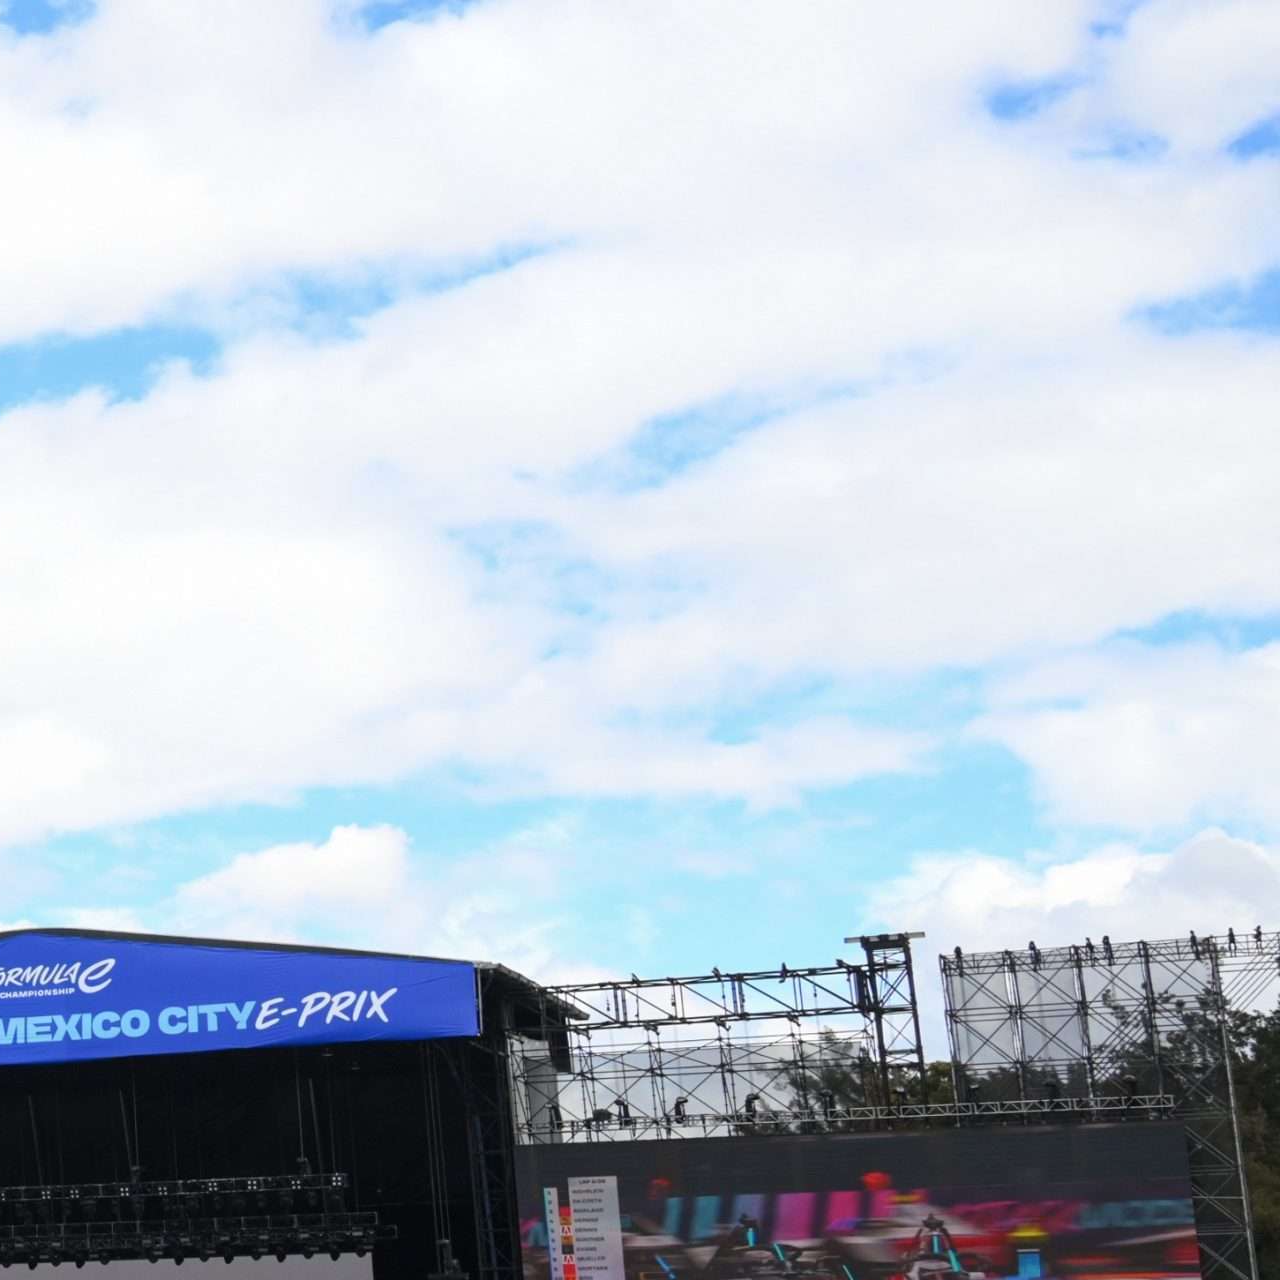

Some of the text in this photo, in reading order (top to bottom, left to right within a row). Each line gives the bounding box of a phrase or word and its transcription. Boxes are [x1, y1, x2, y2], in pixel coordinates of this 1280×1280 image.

[0, 988, 75, 999] CHAMPIONSHIP
[158, 1001, 257, 1035] CITY
[255, 987, 398, 1031] E-PRIX
